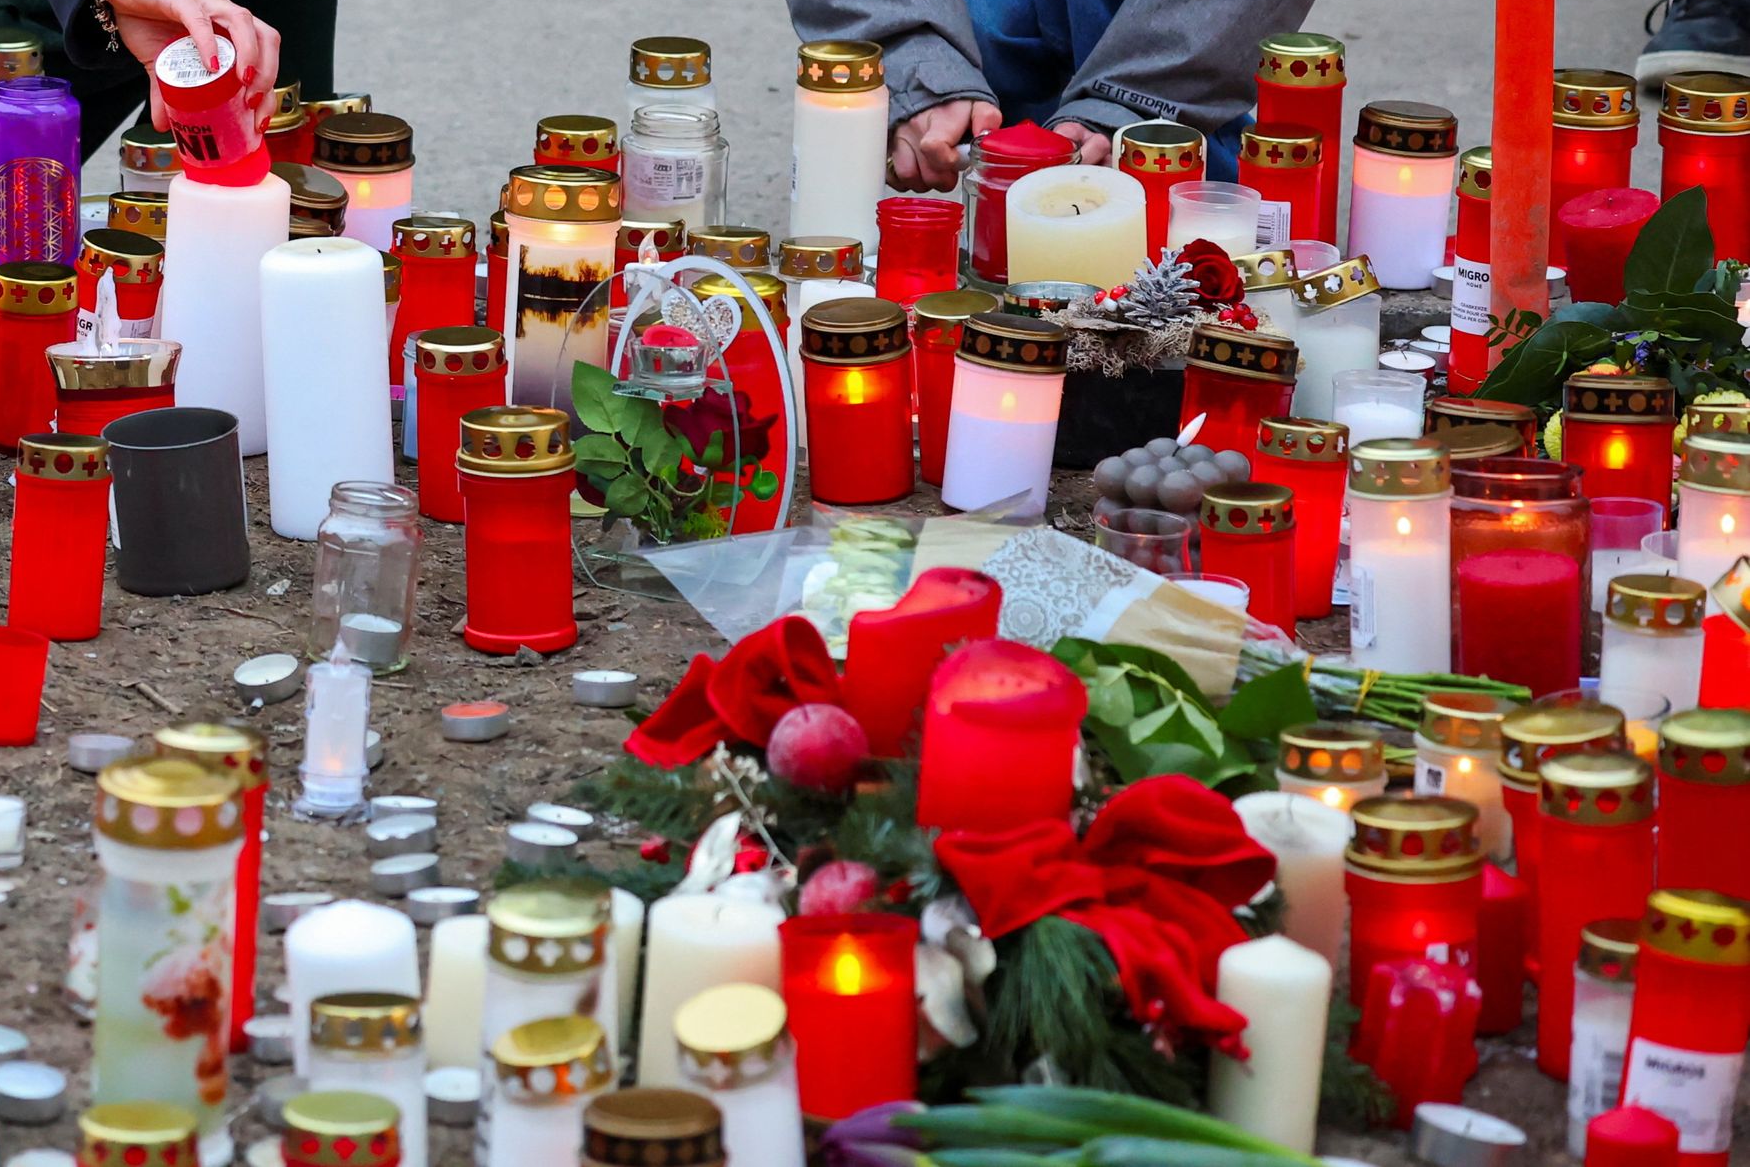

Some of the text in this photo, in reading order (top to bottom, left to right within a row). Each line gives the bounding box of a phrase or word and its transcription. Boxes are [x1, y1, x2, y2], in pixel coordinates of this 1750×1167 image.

[1092, 79, 1177, 115] LET IT STORM
[1458, 266, 1490, 283] MIGRO
[1645, 1056, 1705, 1079] MIGROS
